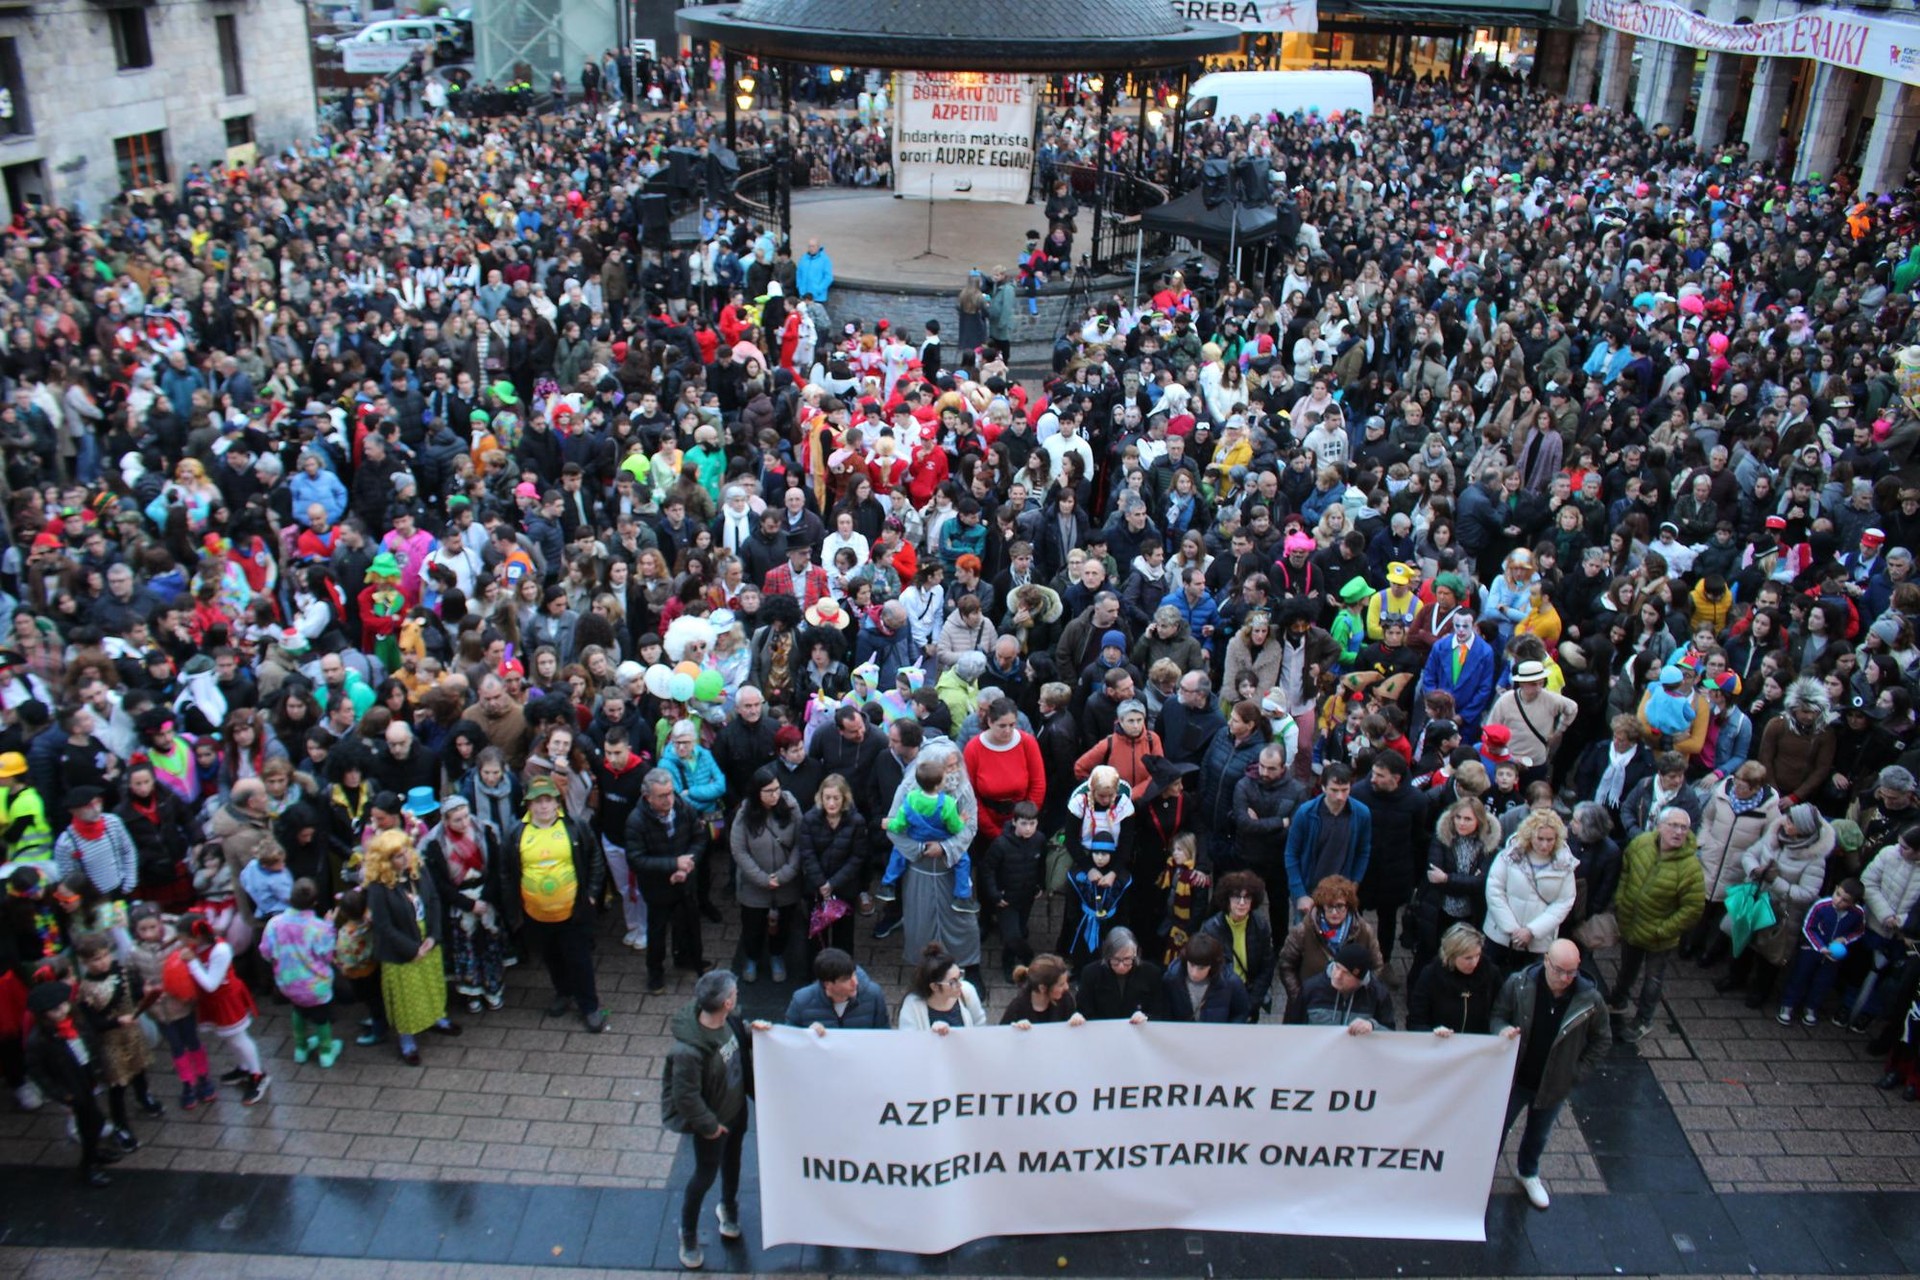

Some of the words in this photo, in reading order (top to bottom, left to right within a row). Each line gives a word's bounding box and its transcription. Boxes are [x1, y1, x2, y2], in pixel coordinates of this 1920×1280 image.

[1170, 1, 1262, 23] GREBA
[1791, 16, 1870, 66] ERAIKI
[913, 85, 983, 102] BORTXATU
[987, 88, 1021, 104] DUTE
[932, 103, 998, 122] AZPEITIN
[899, 129, 967, 144] Indarkeria
[970, 132, 1029, 148] matxista
[900, 150, 931, 162] orori
[935, 147, 985, 166] AURRE
[989, 150, 1030, 170] EGIN!
[878, 1090, 1078, 1126] AZPEITIKO
[1092, 1083, 1257, 1111] HERRIAK
[1269, 1088, 1316, 1112] EZ
[1328, 1089, 1378, 1112] DU
[802, 1152, 1007, 1187] INDARKERIA
[1017, 1142, 1251, 1173] MATXISTARIK
[1258, 1144, 1445, 1172] ONARTZEN
